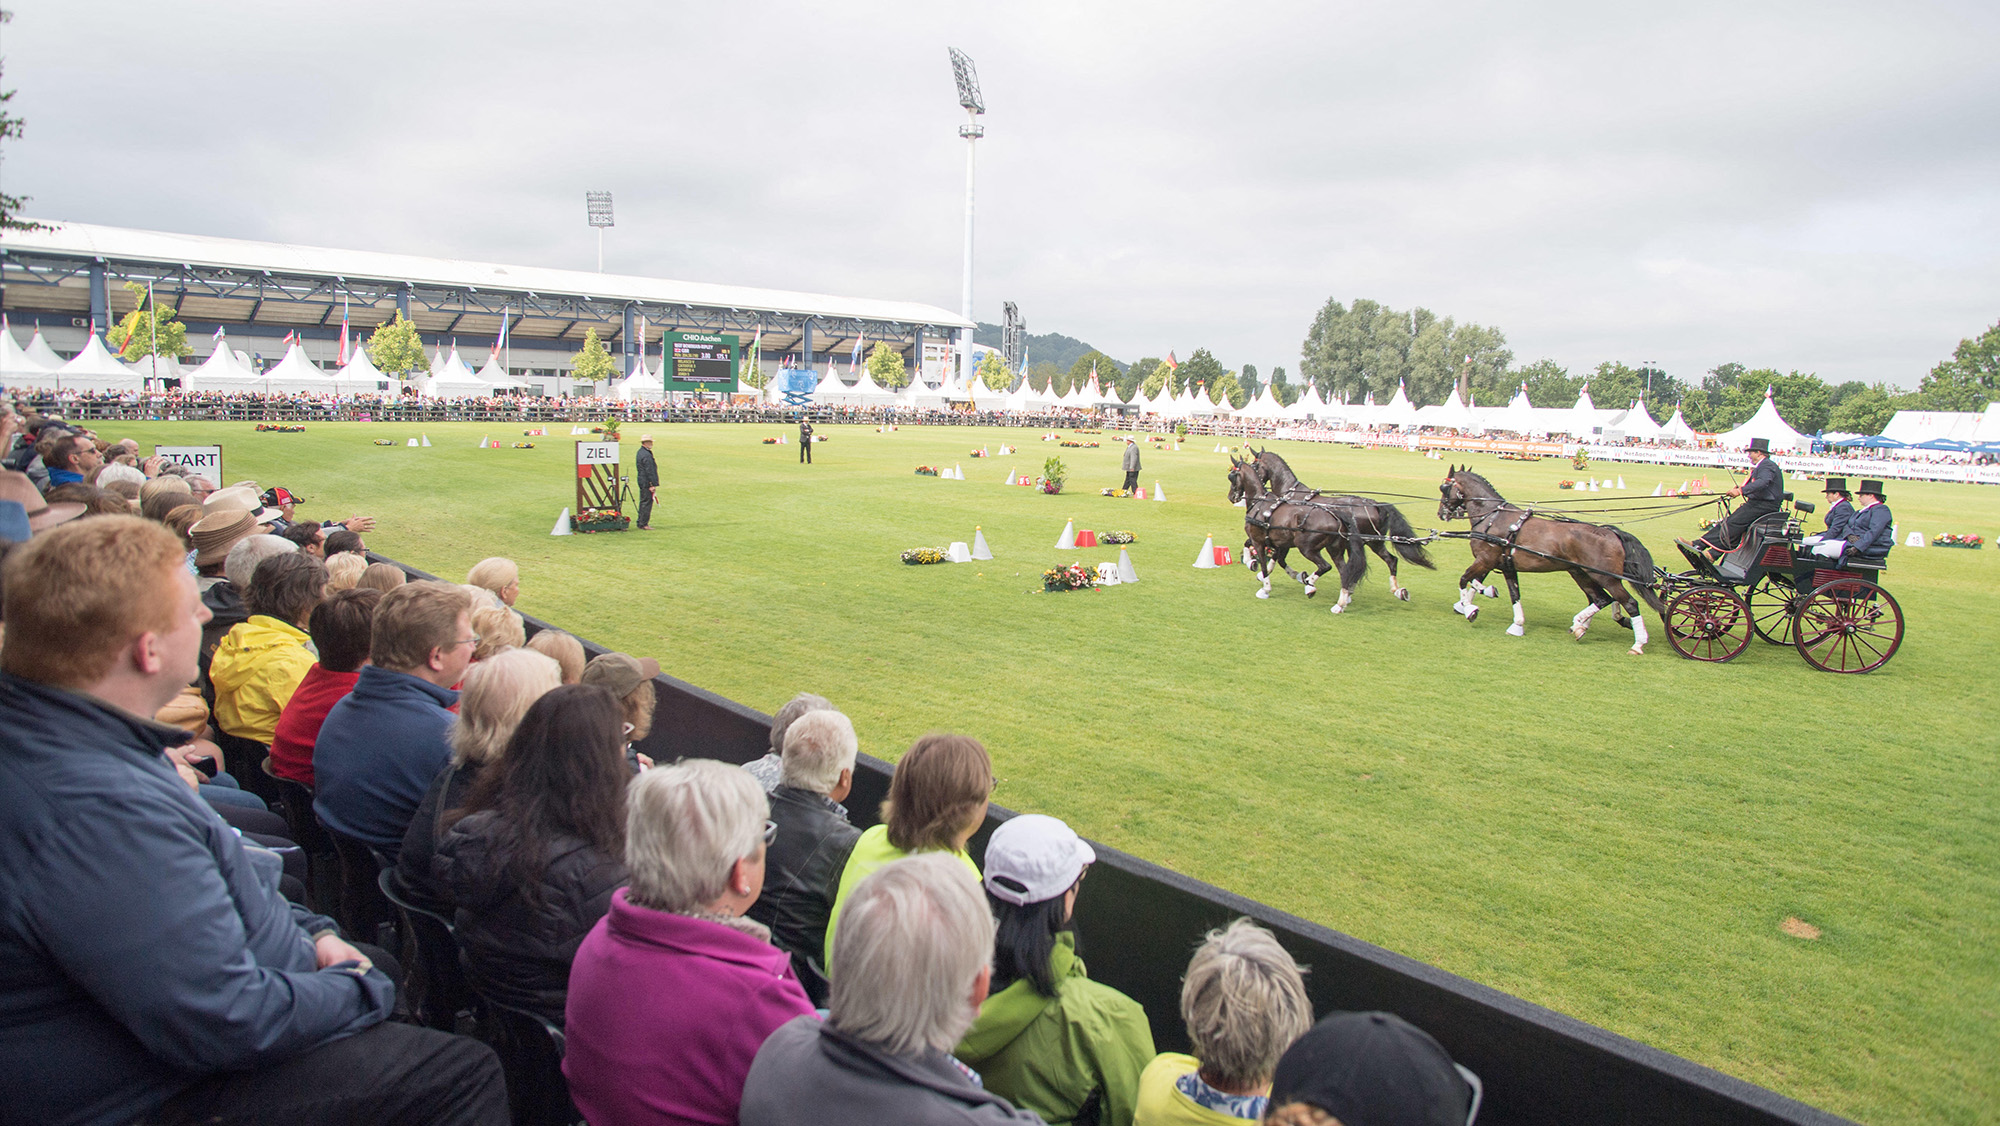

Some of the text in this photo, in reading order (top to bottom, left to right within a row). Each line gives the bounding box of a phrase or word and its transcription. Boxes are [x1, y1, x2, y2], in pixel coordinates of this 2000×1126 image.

[586, 447, 611, 458] ZIEL
[1624, 450, 1657, 458] NetAachen
[161, 453, 217, 466] TART
[1674, 453, 1709, 461] NetAachen
[1785, 459, 1824, 467] NetAachen
[1845, 463, 1887, 471] NetAachen
[1910, 467, 1955, 475] NetAachen
[1912, 536, 1920, 545] 18
